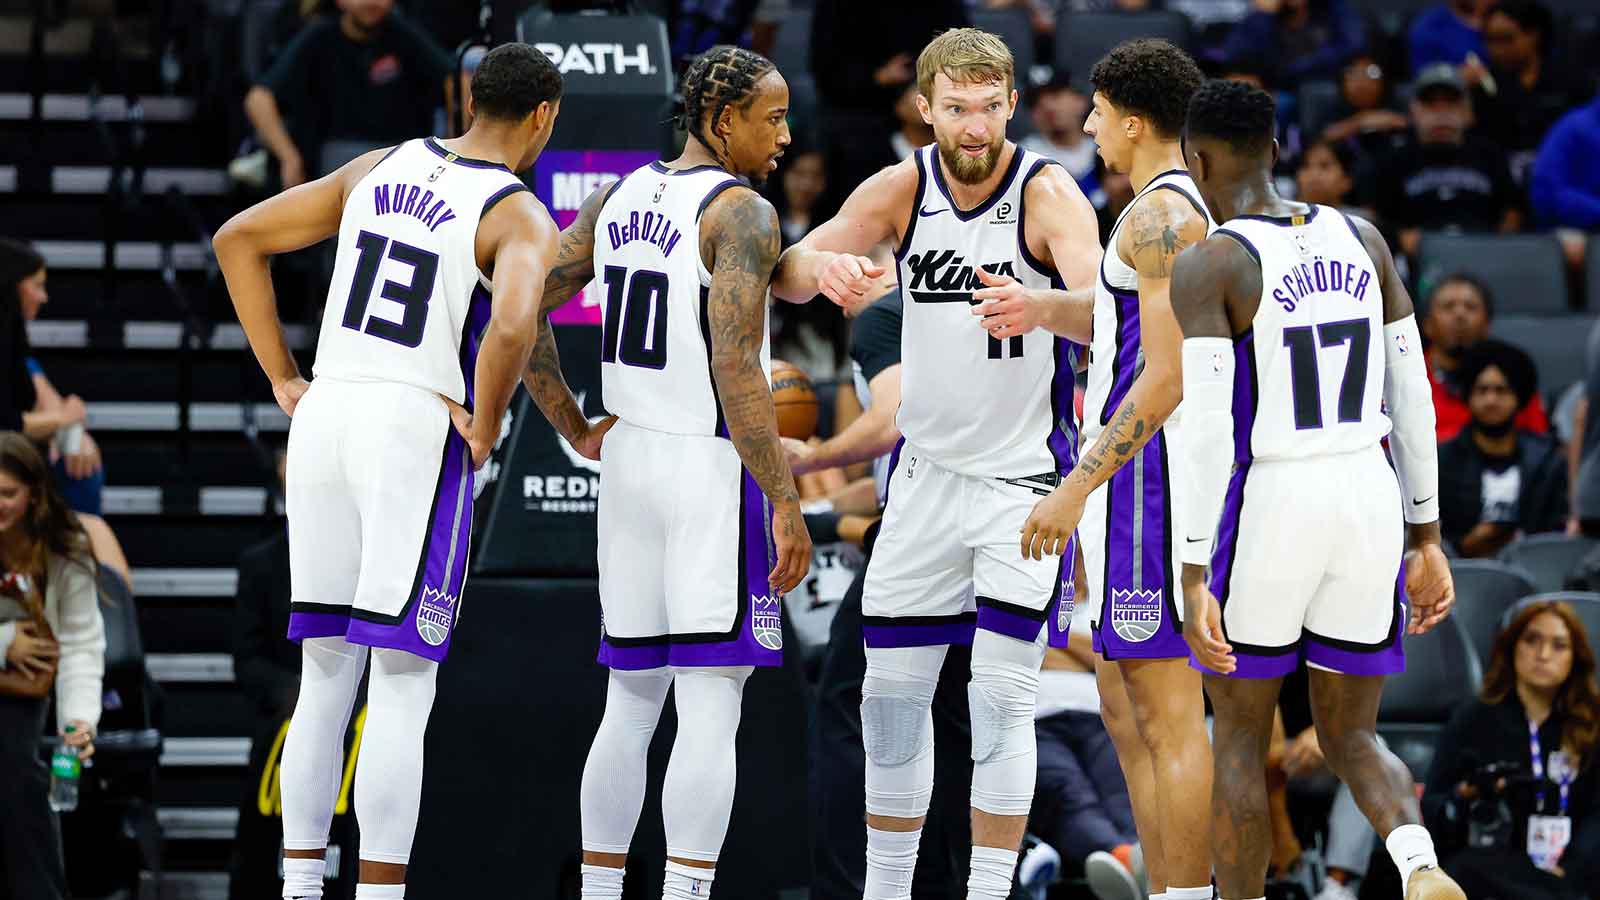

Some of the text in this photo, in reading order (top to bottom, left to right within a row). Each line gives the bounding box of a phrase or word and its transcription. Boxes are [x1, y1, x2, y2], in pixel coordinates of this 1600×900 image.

[375, 183, 456, 232] MURRAY
[342, 229, 440, 348] 13
[907, 249, 1023, 305] Kin
[1273, 256, 1371, 312] SCHRÖDER
[602, 264, 669, 370] 10
[1283, 317, 1371, 430] 17
[419, 608, 451, 629] KINGS
[754, 617, 782, 629] KING
[1114, 610, 1160, 621] KINGS
